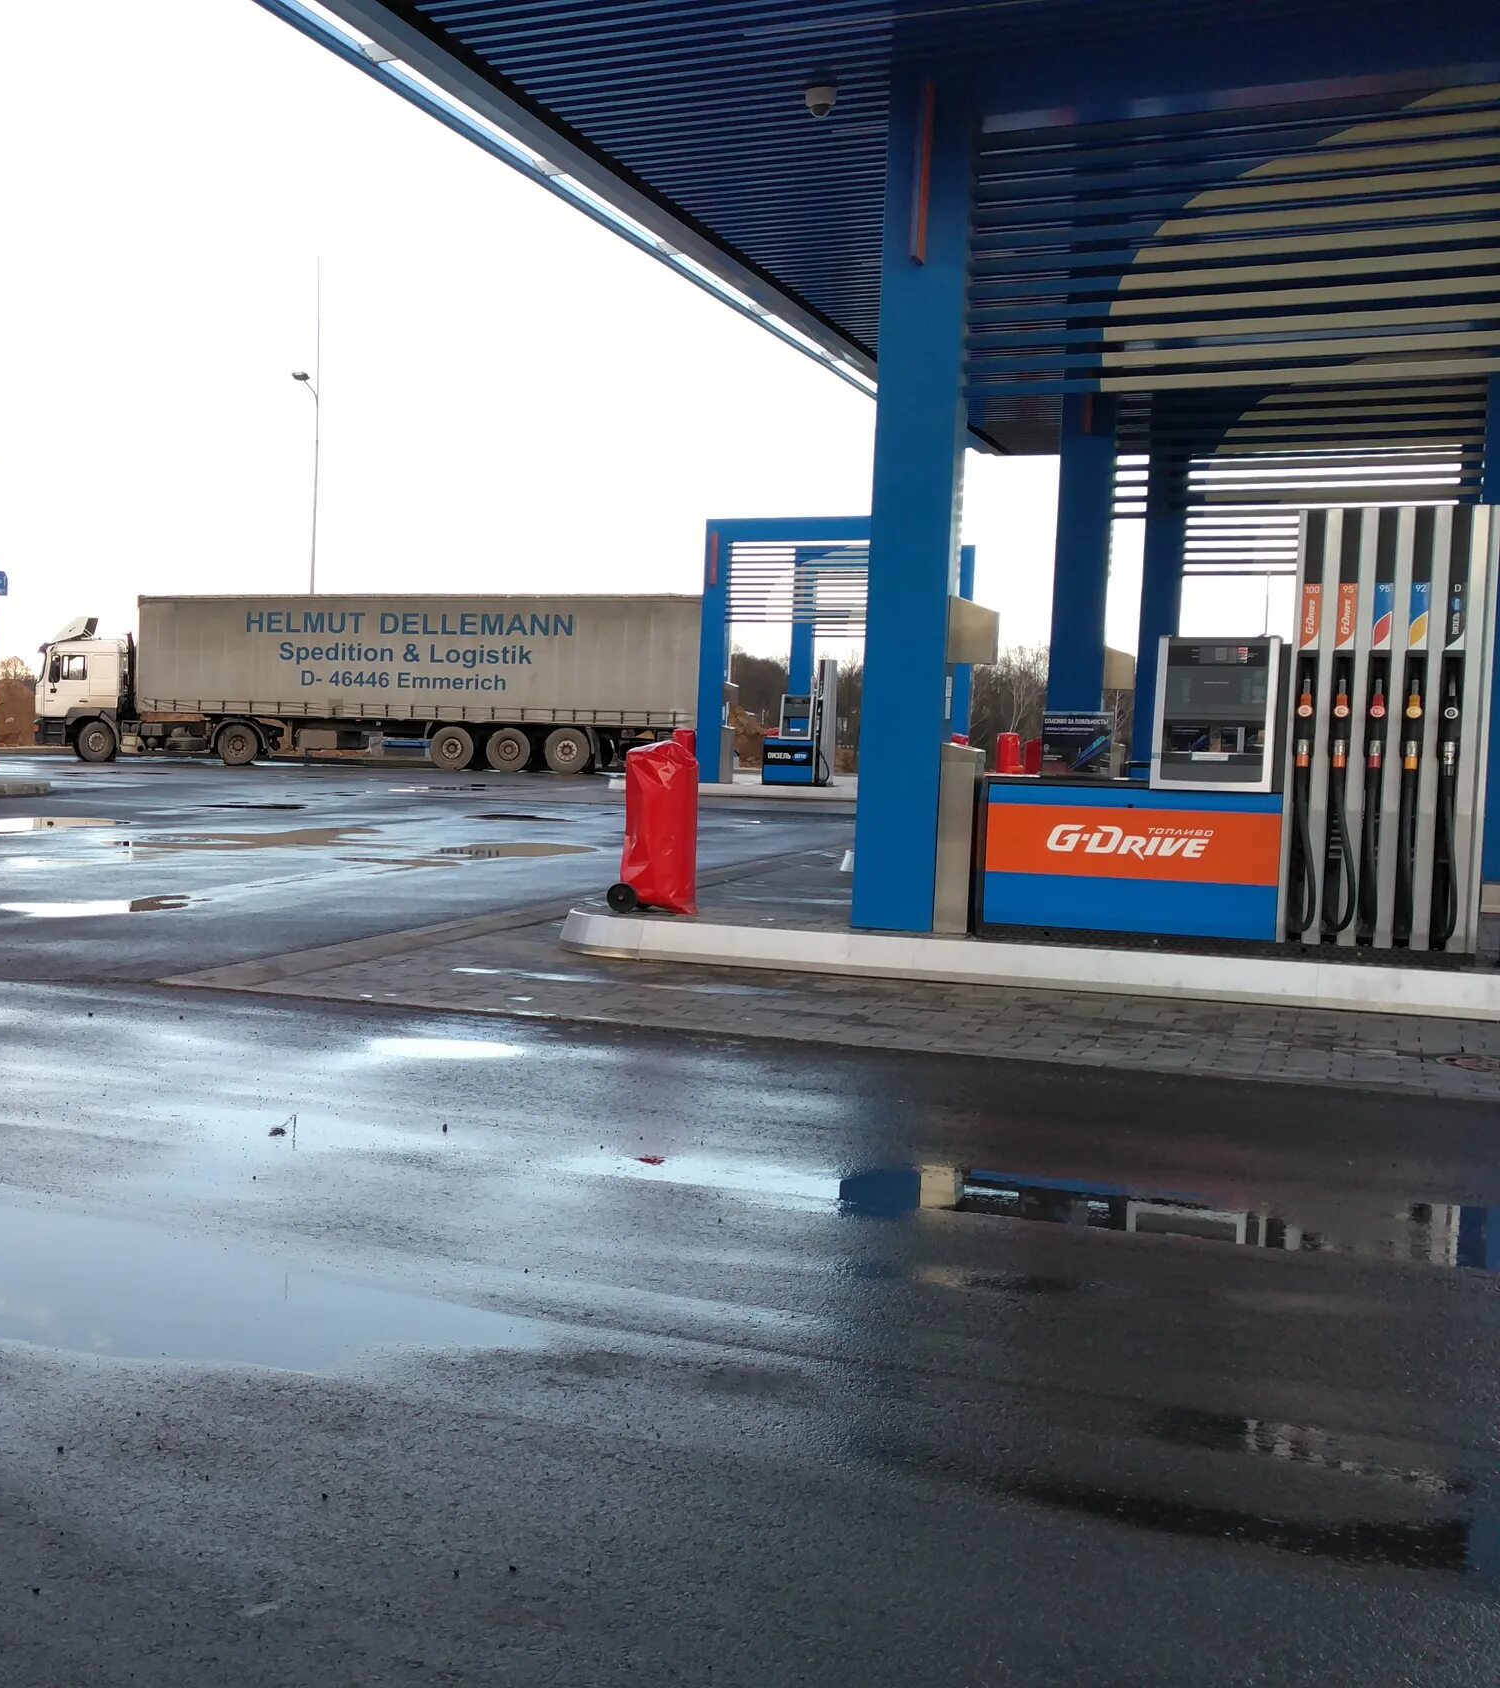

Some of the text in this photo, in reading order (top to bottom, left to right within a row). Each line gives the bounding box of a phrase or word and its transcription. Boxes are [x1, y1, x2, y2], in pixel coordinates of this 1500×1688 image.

[1305, 585, 1320, 594] 100
[1343, 585, 1354, 593] 95
[1379, 584, 1391, 593] 95
[1415, 584, 1427, 593] 92
[1454, 584, 1462, 592] D
[246, 611, 574, 636] HELMUT DELLEMANN
[279, 641, 533, 669] Spedition & Logistik
[300, 670, 507, 691] D- 46446 Emmerich
[1148, 827, 1214, 837] ТОПЛИВО
